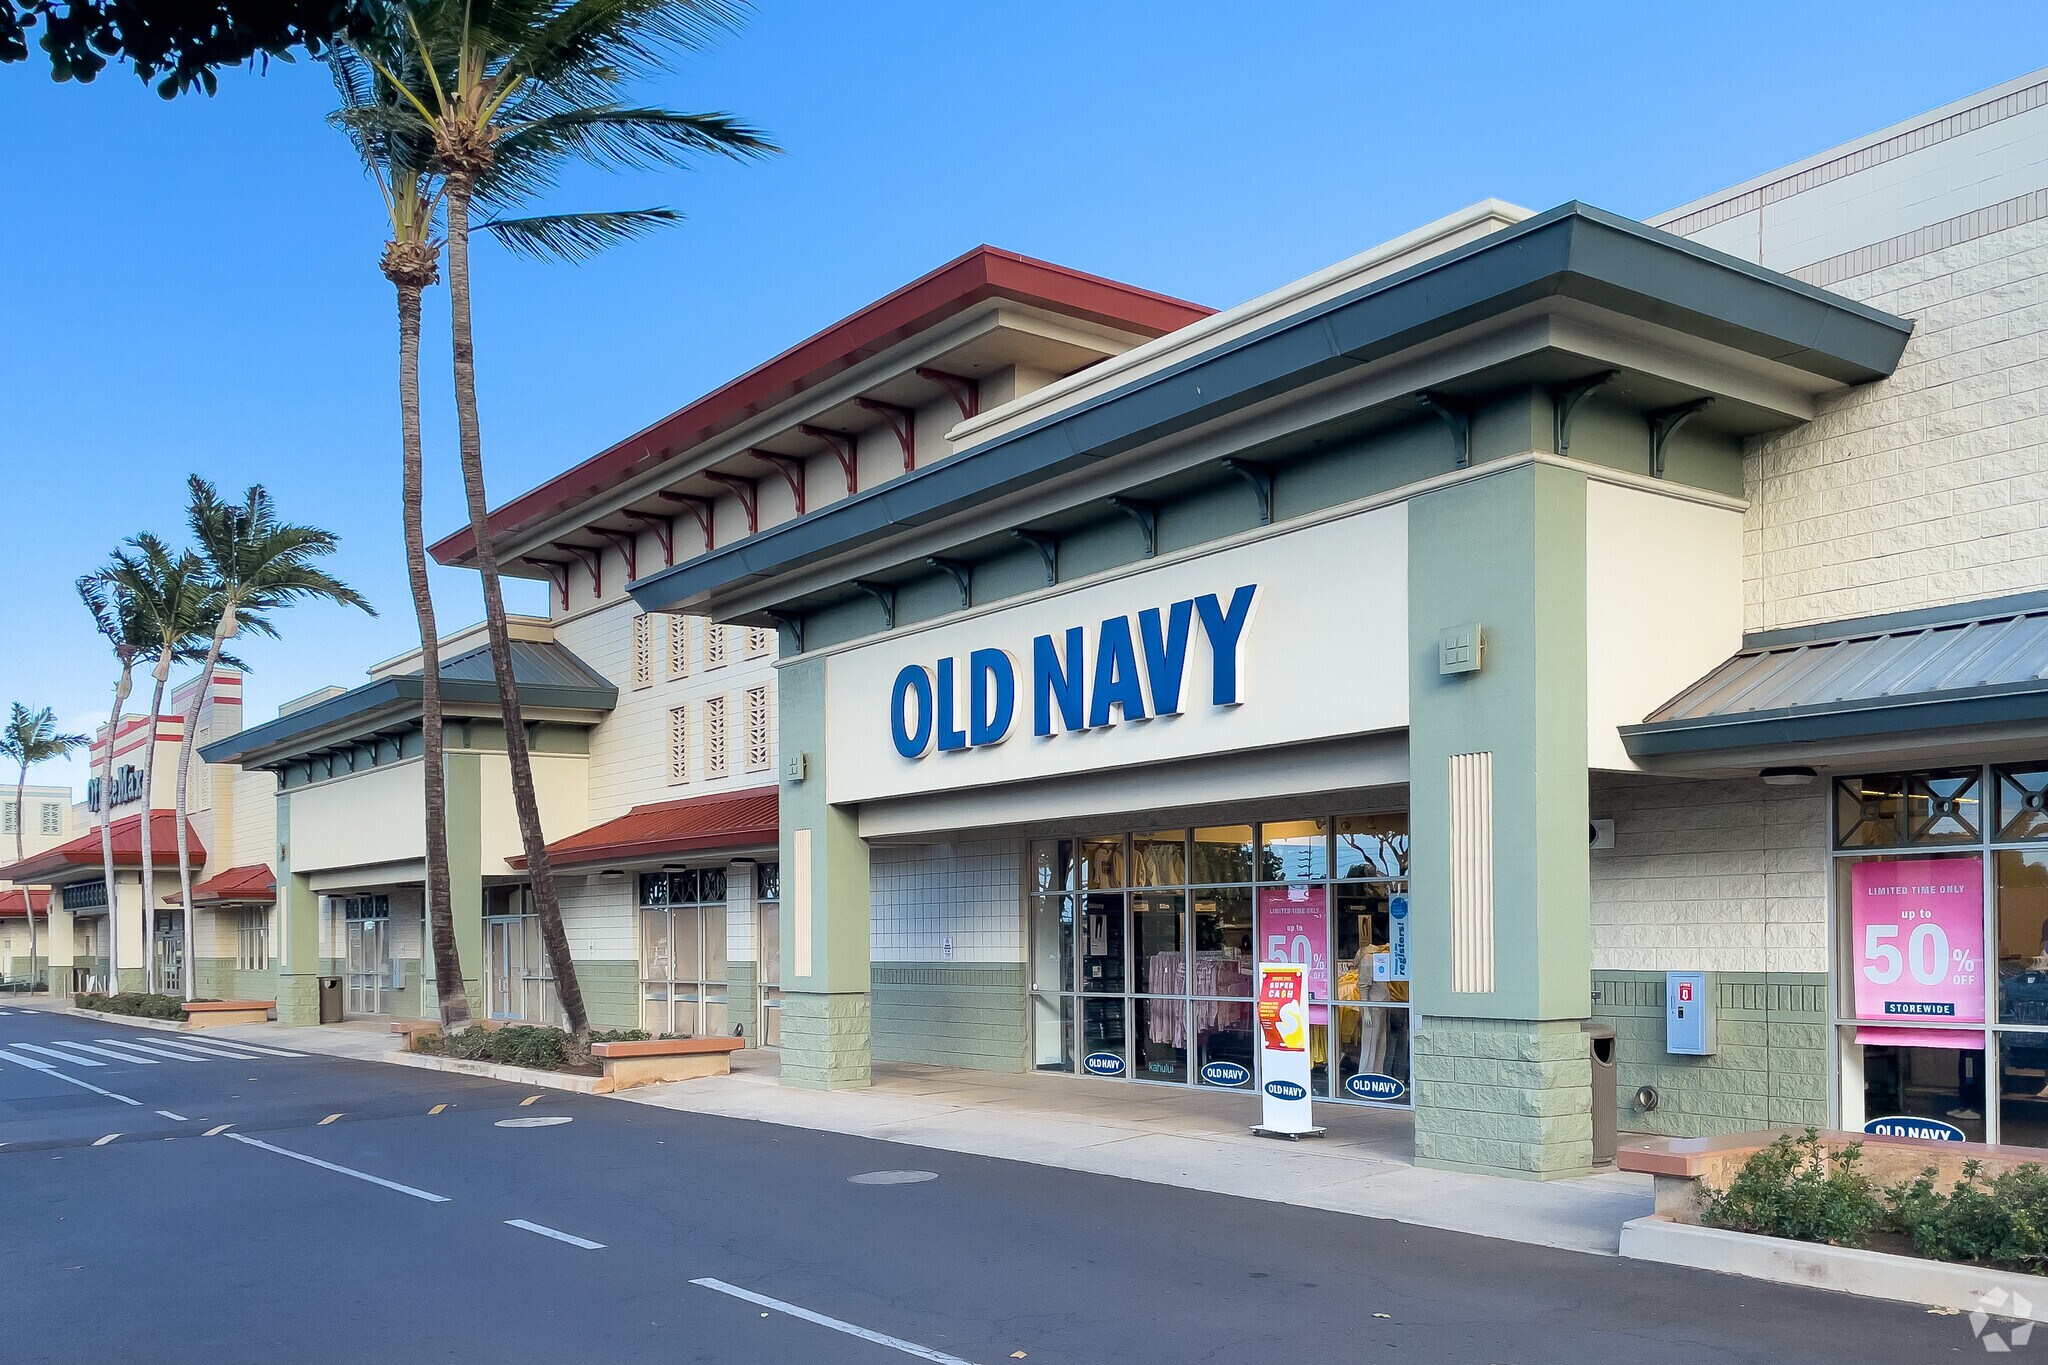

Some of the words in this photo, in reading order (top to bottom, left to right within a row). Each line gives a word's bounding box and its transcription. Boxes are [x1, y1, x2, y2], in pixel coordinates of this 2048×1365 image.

[891, 648, 1020, 759] OLD
[1034, 584, 1260, 737] NAVY
[88, 764, 144, 812] OfeMax
[1868, 886, 1908, 896] LIMITED
[1912, 885, 1936, 895] TIME
[1940, 884, 1965, 894] ONLY
[1269, 907, 1291, 915] LIMITED
[1292, 907, 1306, 915] TIME
[1901, 909, 1916, 920] up
[1919, 908, 1932, 918] to
[1286, 925, 1295, 933] up
[1313, 972, 1325, 980] OFF
[1953, 975, 1975, 985] OFF
[1889, 1004, 1950, 1014] STOREWIDE
[1089, 1059, 1102, 1068] OLD
[1102, 1060, 1120, 1070] NAVY
[1148, 1062, 1174, 1074] kahului
[1207, 1068, 1222, 1079] OLD
[1222, 1069, 1244, 1080] NAVY
[1268, 1083, 1283, 1095] OLD
[1283, 1085, 1303, 1098] NAVY
[1353, 1079, 1370, 1092] OLD
[1371, 1081, 1397, 1094] NAVY
[1908, 1126, 1951, 1141] NAVY
